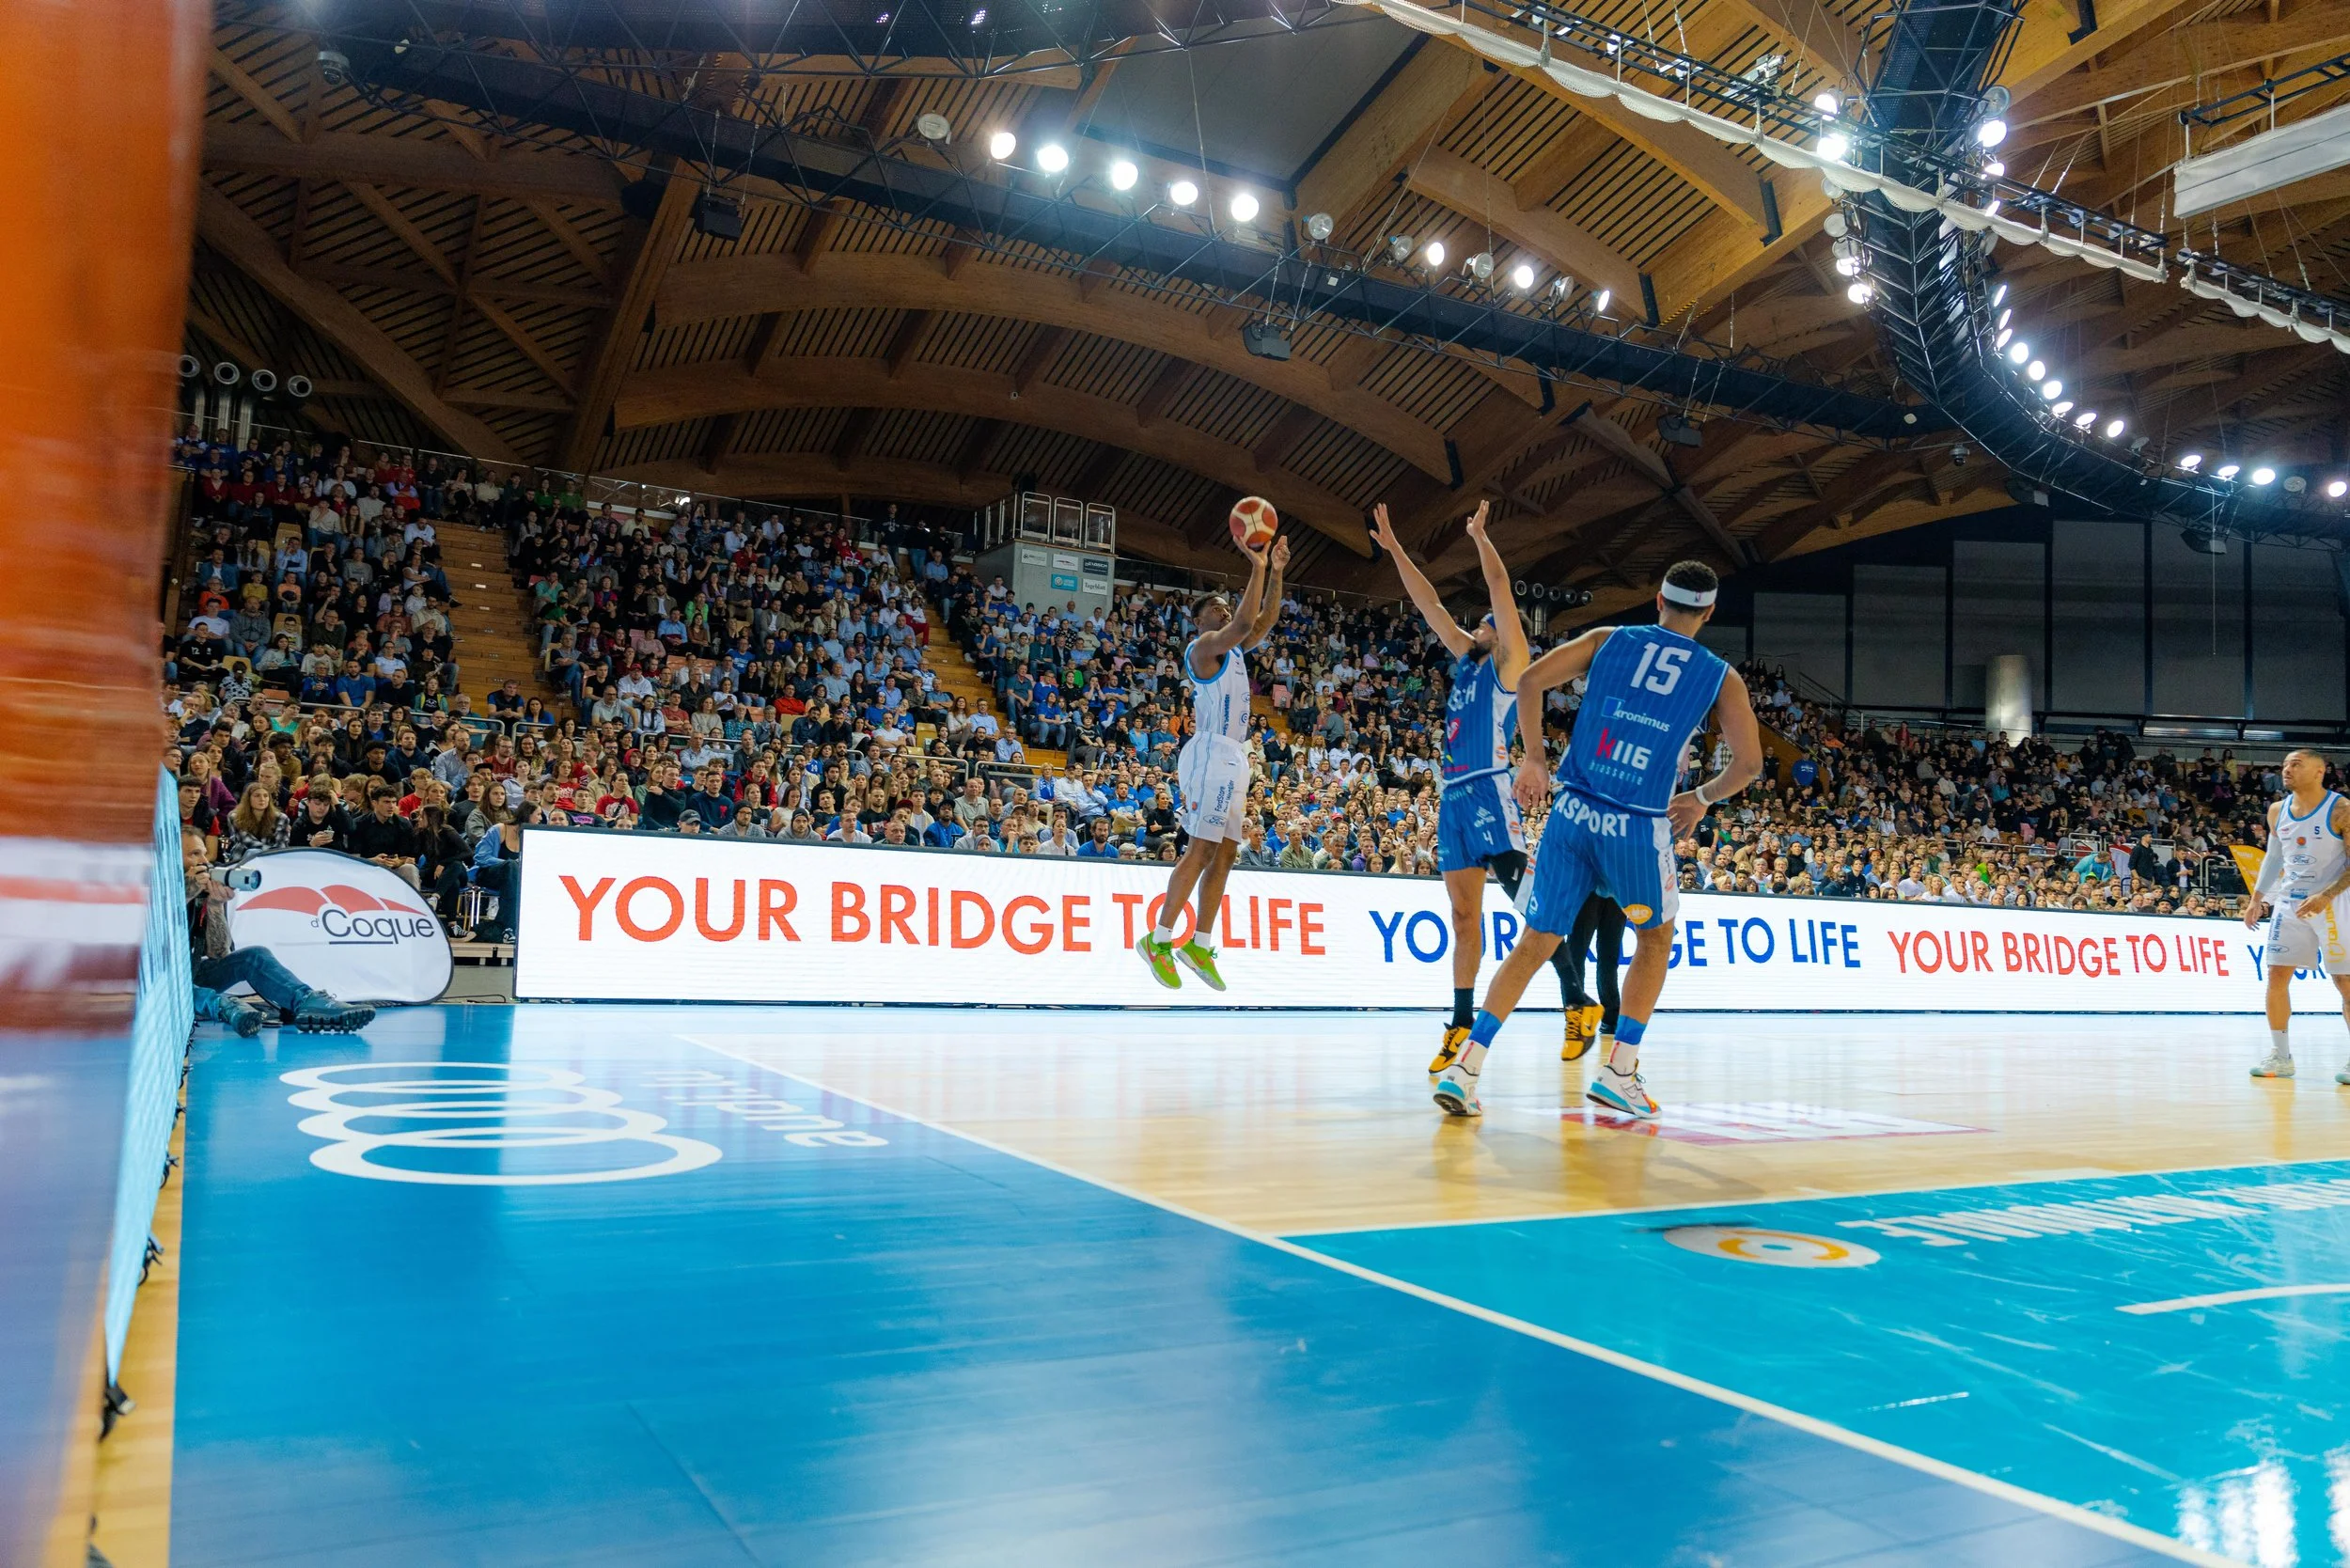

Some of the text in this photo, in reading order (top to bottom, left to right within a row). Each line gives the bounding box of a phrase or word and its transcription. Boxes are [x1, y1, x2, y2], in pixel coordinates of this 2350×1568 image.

[1630, 641, 1692, 696] 15
[1612, 700, 1670, 733] kronimus
[1588, 759, 1644, 786] brasserie
[1481, 829, 1495, 846] 4
[560, 875, 1325, 955] YOUR BRIDGE TO LIFE
[1369, 910, 1519, 964] YOR
[1717, 917, 1775, 964] TO
[1789, 917, 1861, 968] LIFE
[1888, 930, 2230, 978] YOUR BRIDGE TO LIFE
